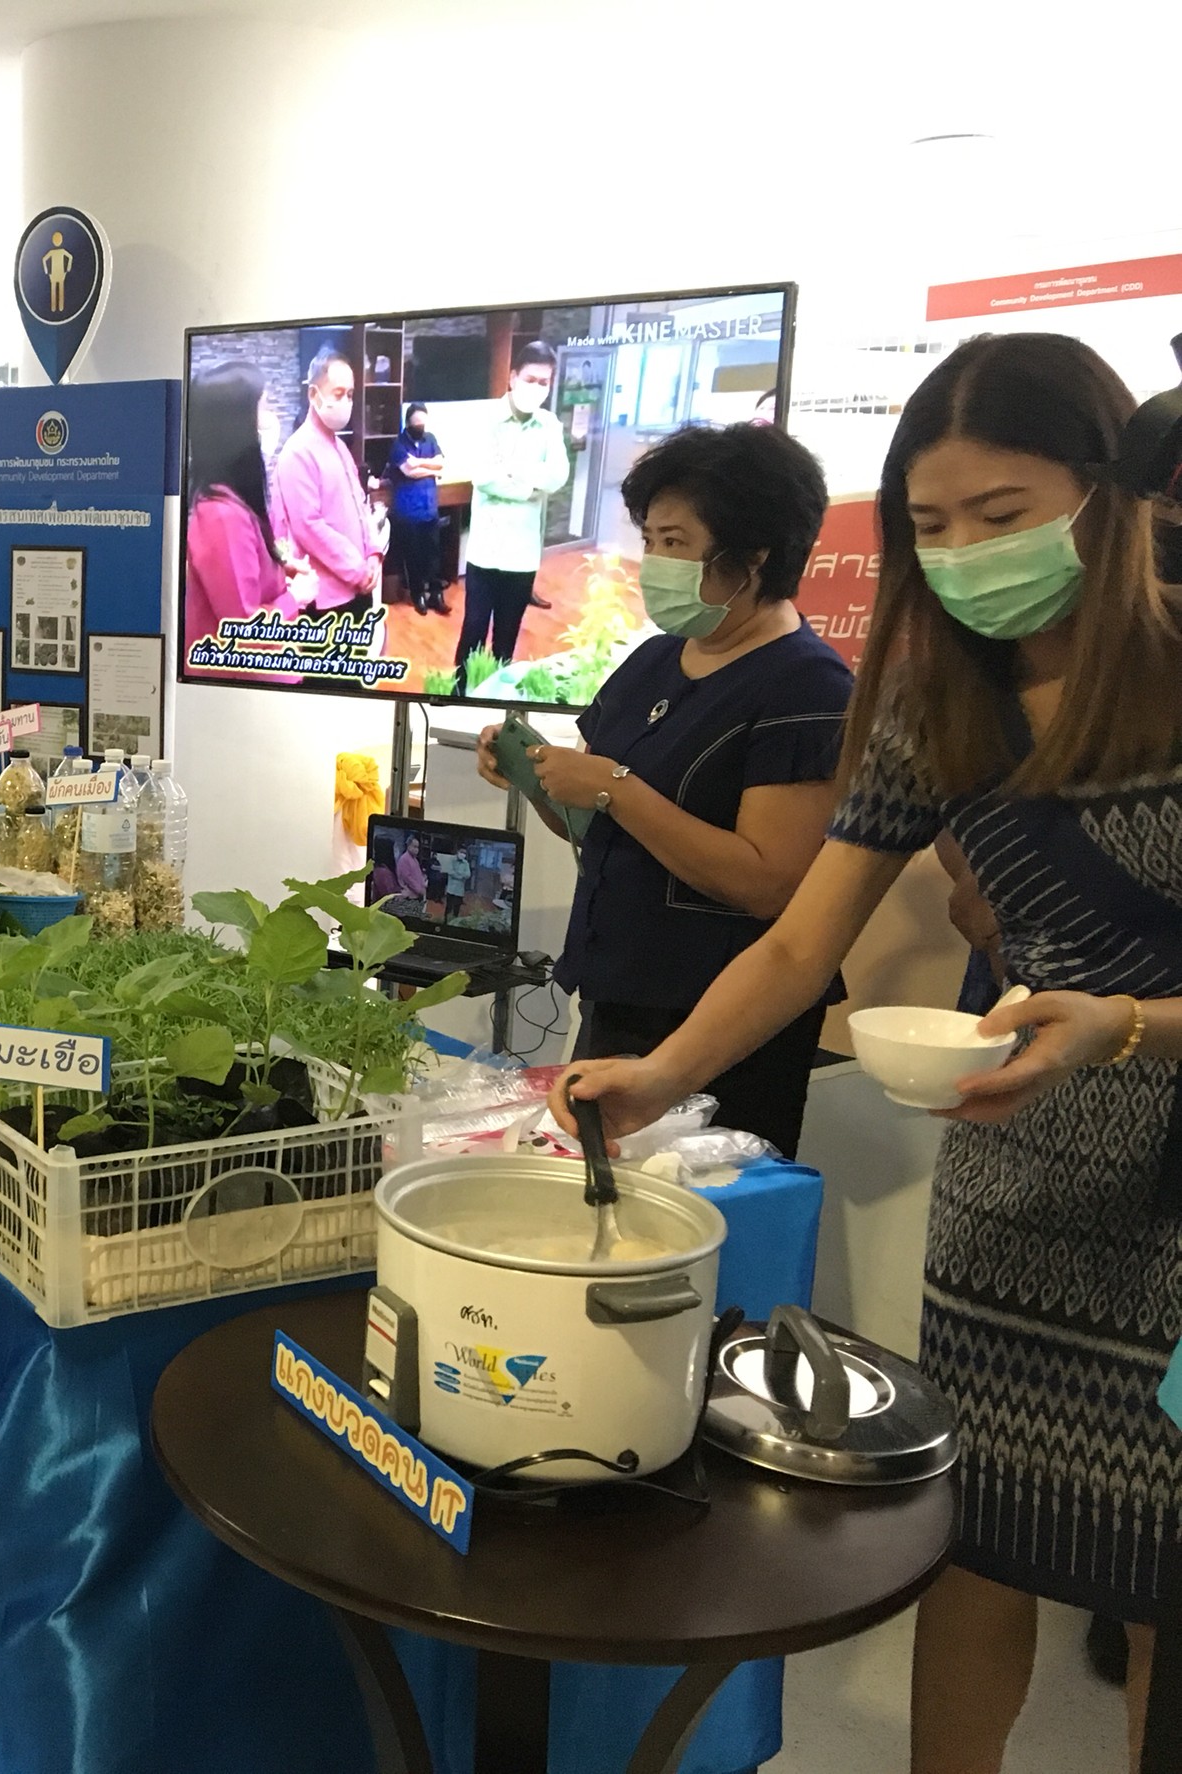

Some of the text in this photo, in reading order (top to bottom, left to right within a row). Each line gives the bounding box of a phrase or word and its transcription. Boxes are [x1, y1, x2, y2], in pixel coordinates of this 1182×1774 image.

[990, 282, 1143, 307] Community Development Department (CDD)
[568, 336, 594, 347] Made
[597, 334, 619, 345] with
[57, 452, 120, 467] กระทรวงมหาดไทย
[29, 471, 74, 482] Development
[77, 470, 120, 481] Department
[191, 638, 407, 684] นักวิชาการคอมพิวเตอร์ชำนาญการ
[48, 775, 112, 799] ผักคนเมือง
[444, 1340, 498, 1374] World
[431, 1477, 466, 1532] IT
